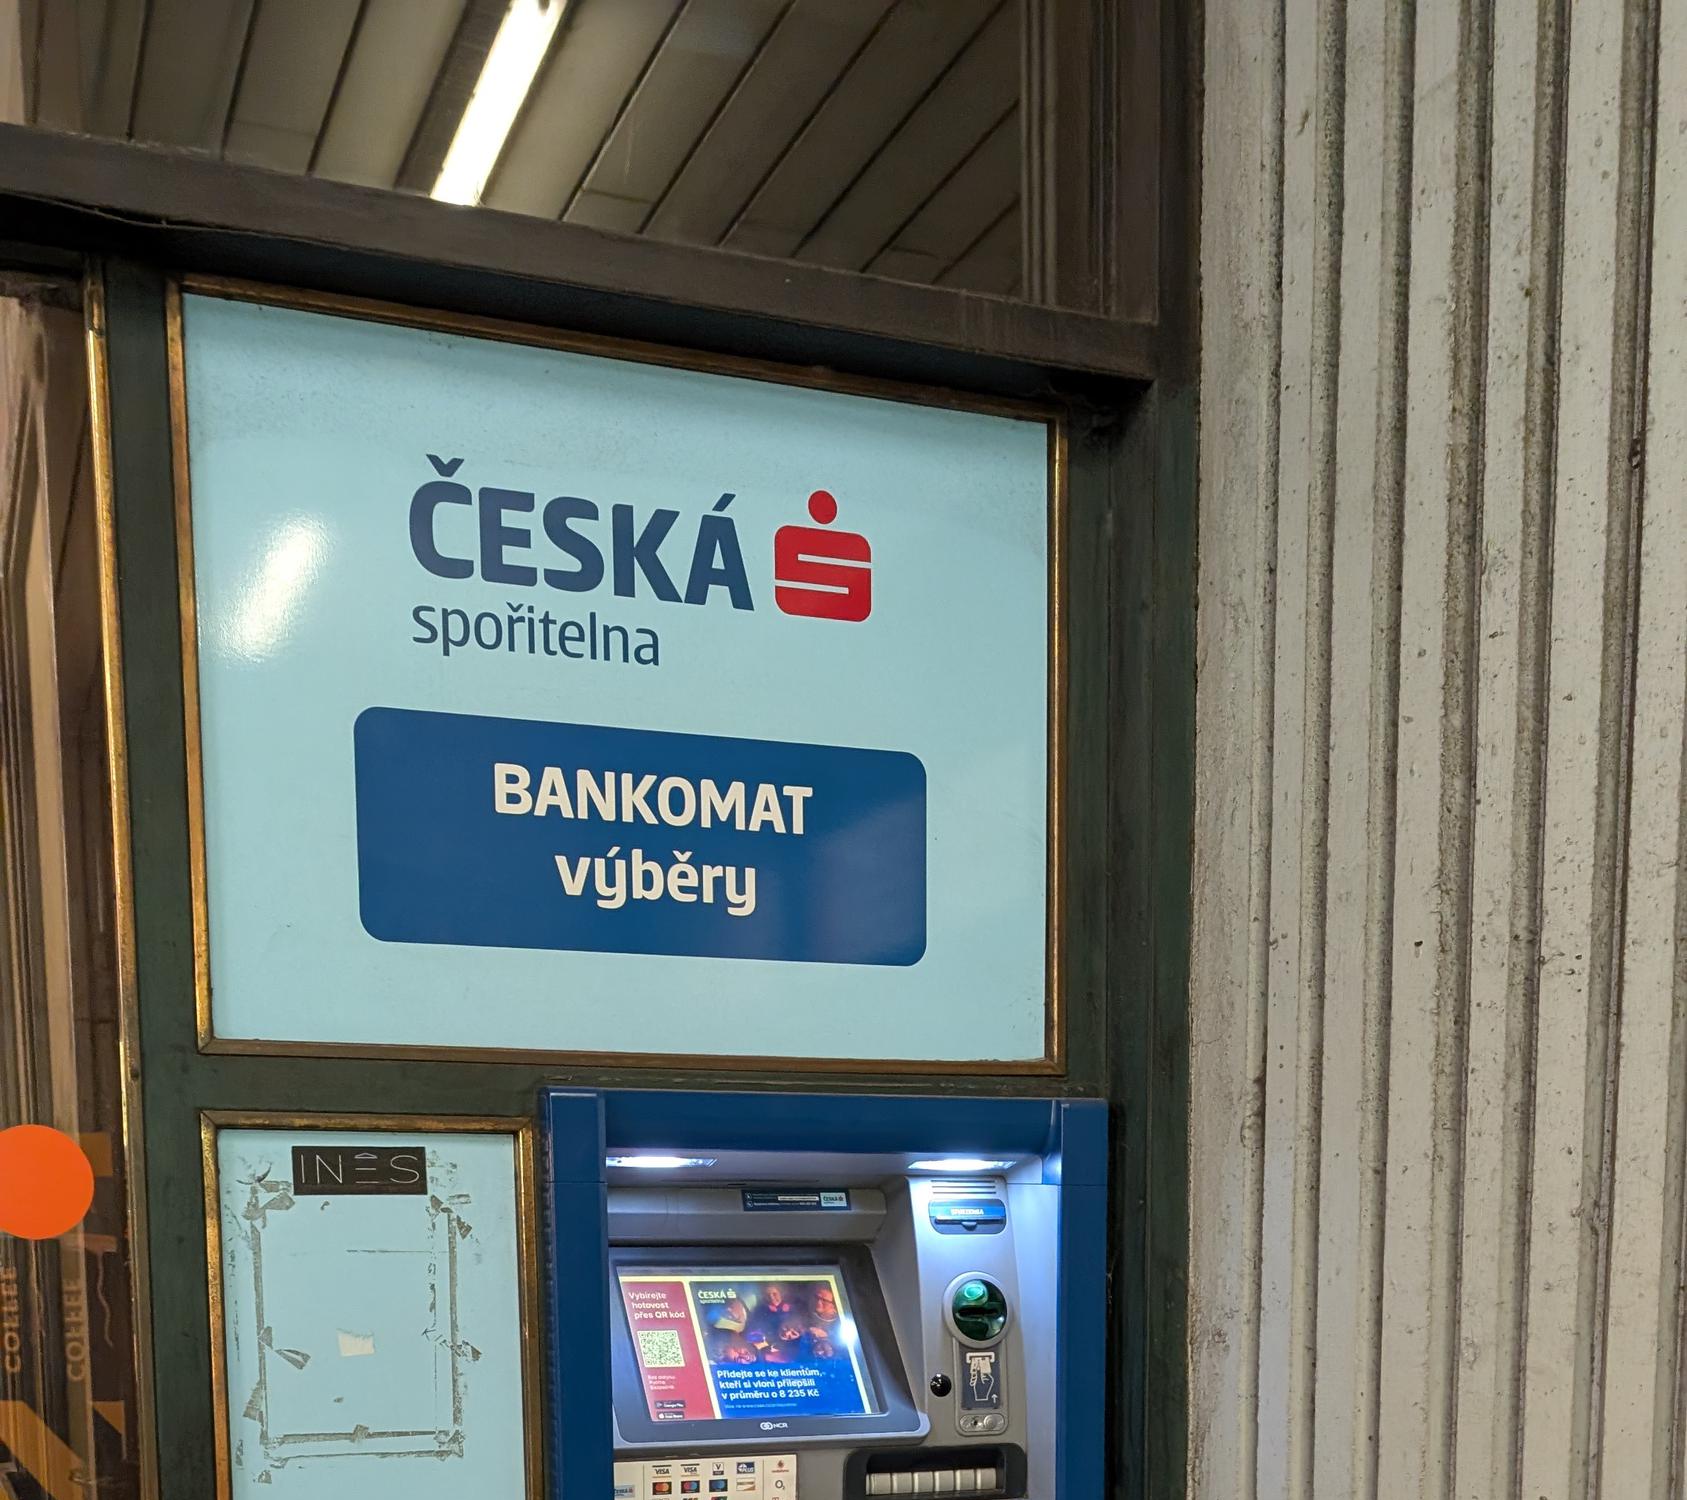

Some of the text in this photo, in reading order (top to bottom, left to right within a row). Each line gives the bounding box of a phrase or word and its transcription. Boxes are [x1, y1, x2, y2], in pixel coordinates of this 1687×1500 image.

[409, 454, 755, 611] ČESKÁ
[411, 601, 660, 666] spořitelna
[493, 762, 813, 835] BANKOMAT
[554, 846, 757, 917] výběry
[655, 1311, 668, 1319] QR
[717, 1369, 753, 1379] Přidejte
[767, 1369, 779, 1378] ke
[743, 1380, 751, 1388] si
[729, 1390, 769, 1401] průměru
[779, 1390, 787, 1398] 8
[788, 1389, 806, 1398] 235
[807, 1388, 820, 1397] Kč
